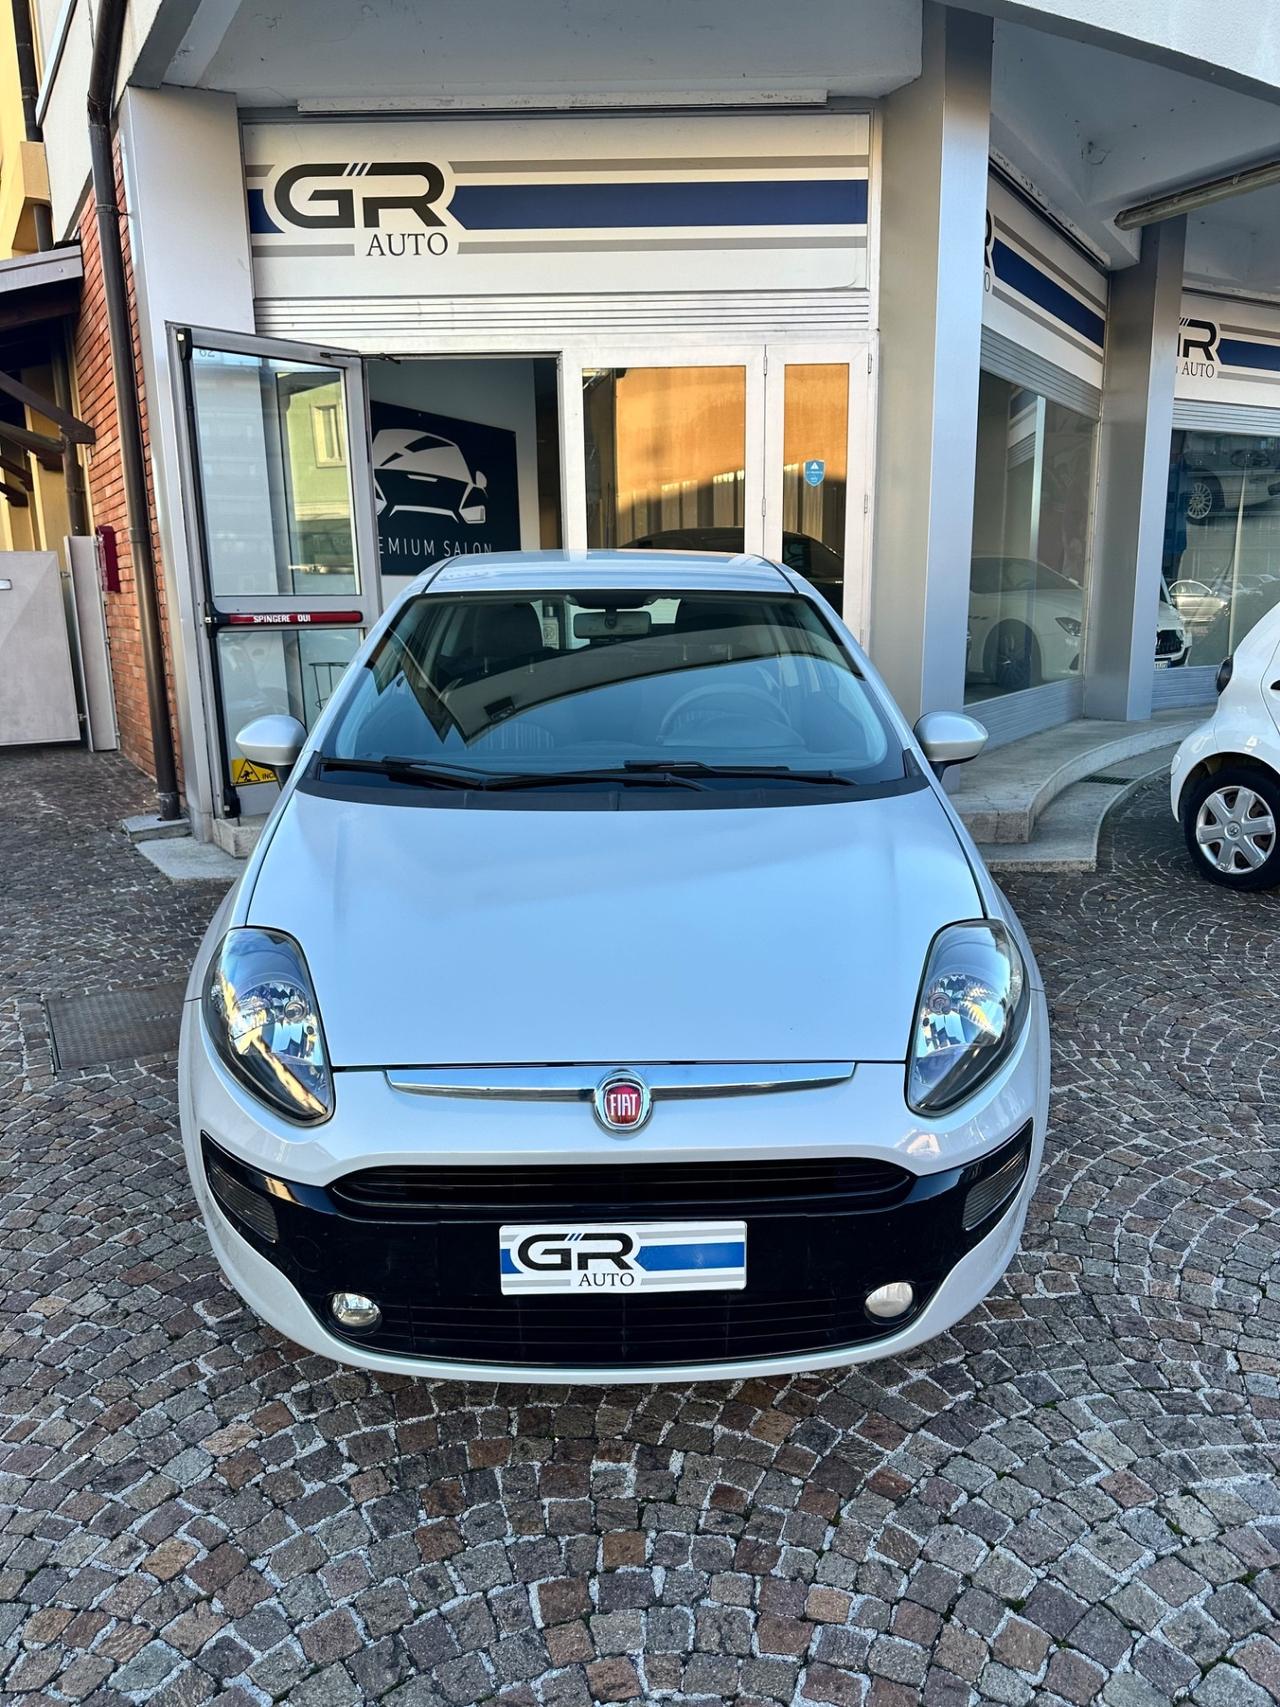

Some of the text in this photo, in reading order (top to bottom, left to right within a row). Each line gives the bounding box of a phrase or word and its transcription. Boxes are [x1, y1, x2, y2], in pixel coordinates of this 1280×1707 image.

[274, 162, 447, 228] GR
[366, 232, 448, 256] AUTO
[1181, 361, 1215, 378] AUTO
[253, 614, 292, 623] SPINGERE
[610, 1093, 638, 1116] FIAT
[517, 1233, 634, 1271] GR
[578, 1272, 635, 1287] AUTO
